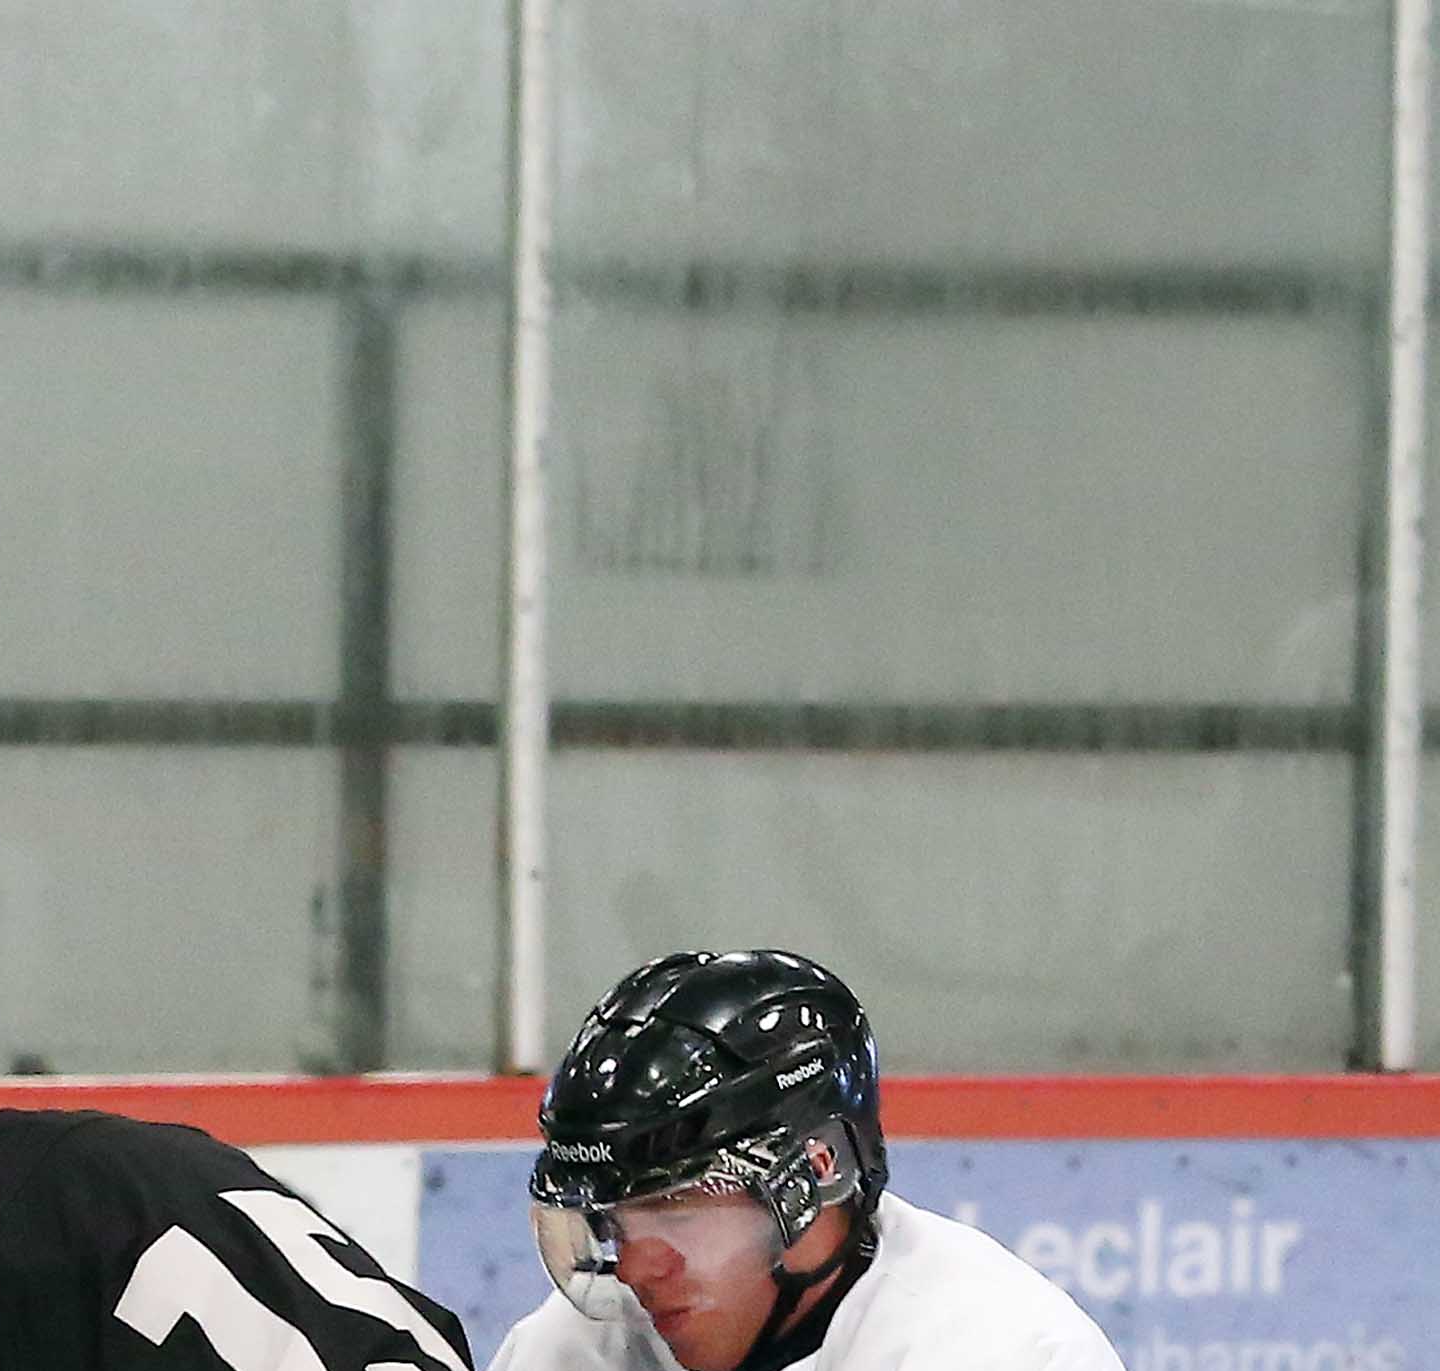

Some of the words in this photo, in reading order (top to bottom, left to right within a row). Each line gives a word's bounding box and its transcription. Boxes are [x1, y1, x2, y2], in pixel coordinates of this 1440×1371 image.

[776, 1056, 826, 1090] Reebok
[550, 1139, 614, 1163] Reebok
[956, 1198, 1304, 1299] eclair
